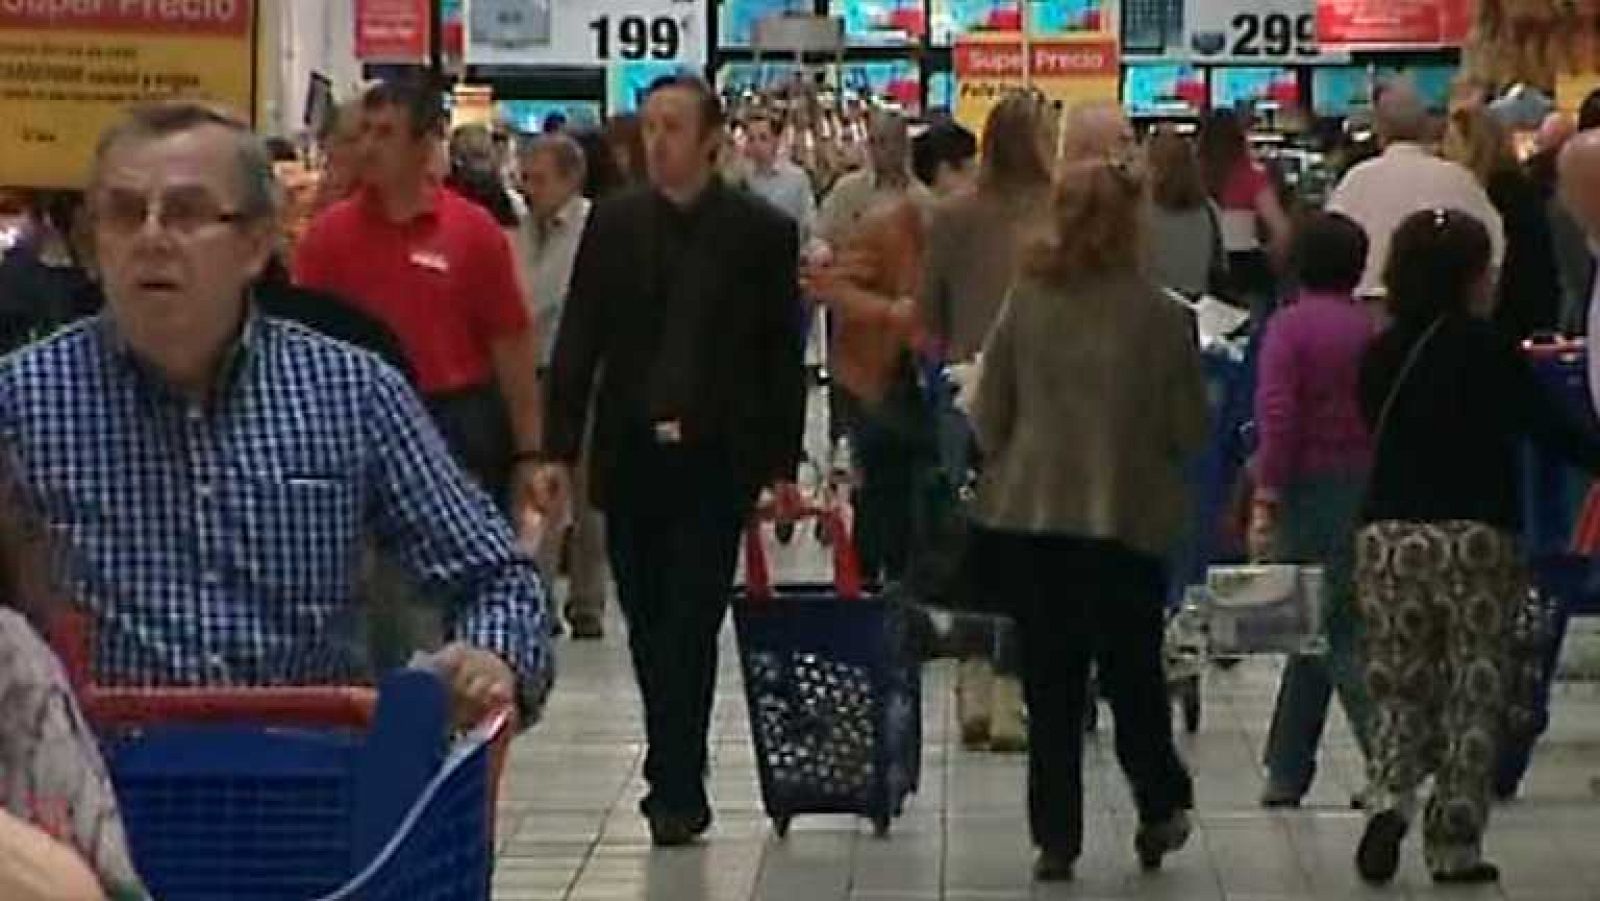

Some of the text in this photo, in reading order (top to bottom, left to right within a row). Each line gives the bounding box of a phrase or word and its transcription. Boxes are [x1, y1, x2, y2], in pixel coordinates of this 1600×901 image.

[1231, 14, 1319, 57] 299
[968, 49, 1104, 72] Supe Precio
